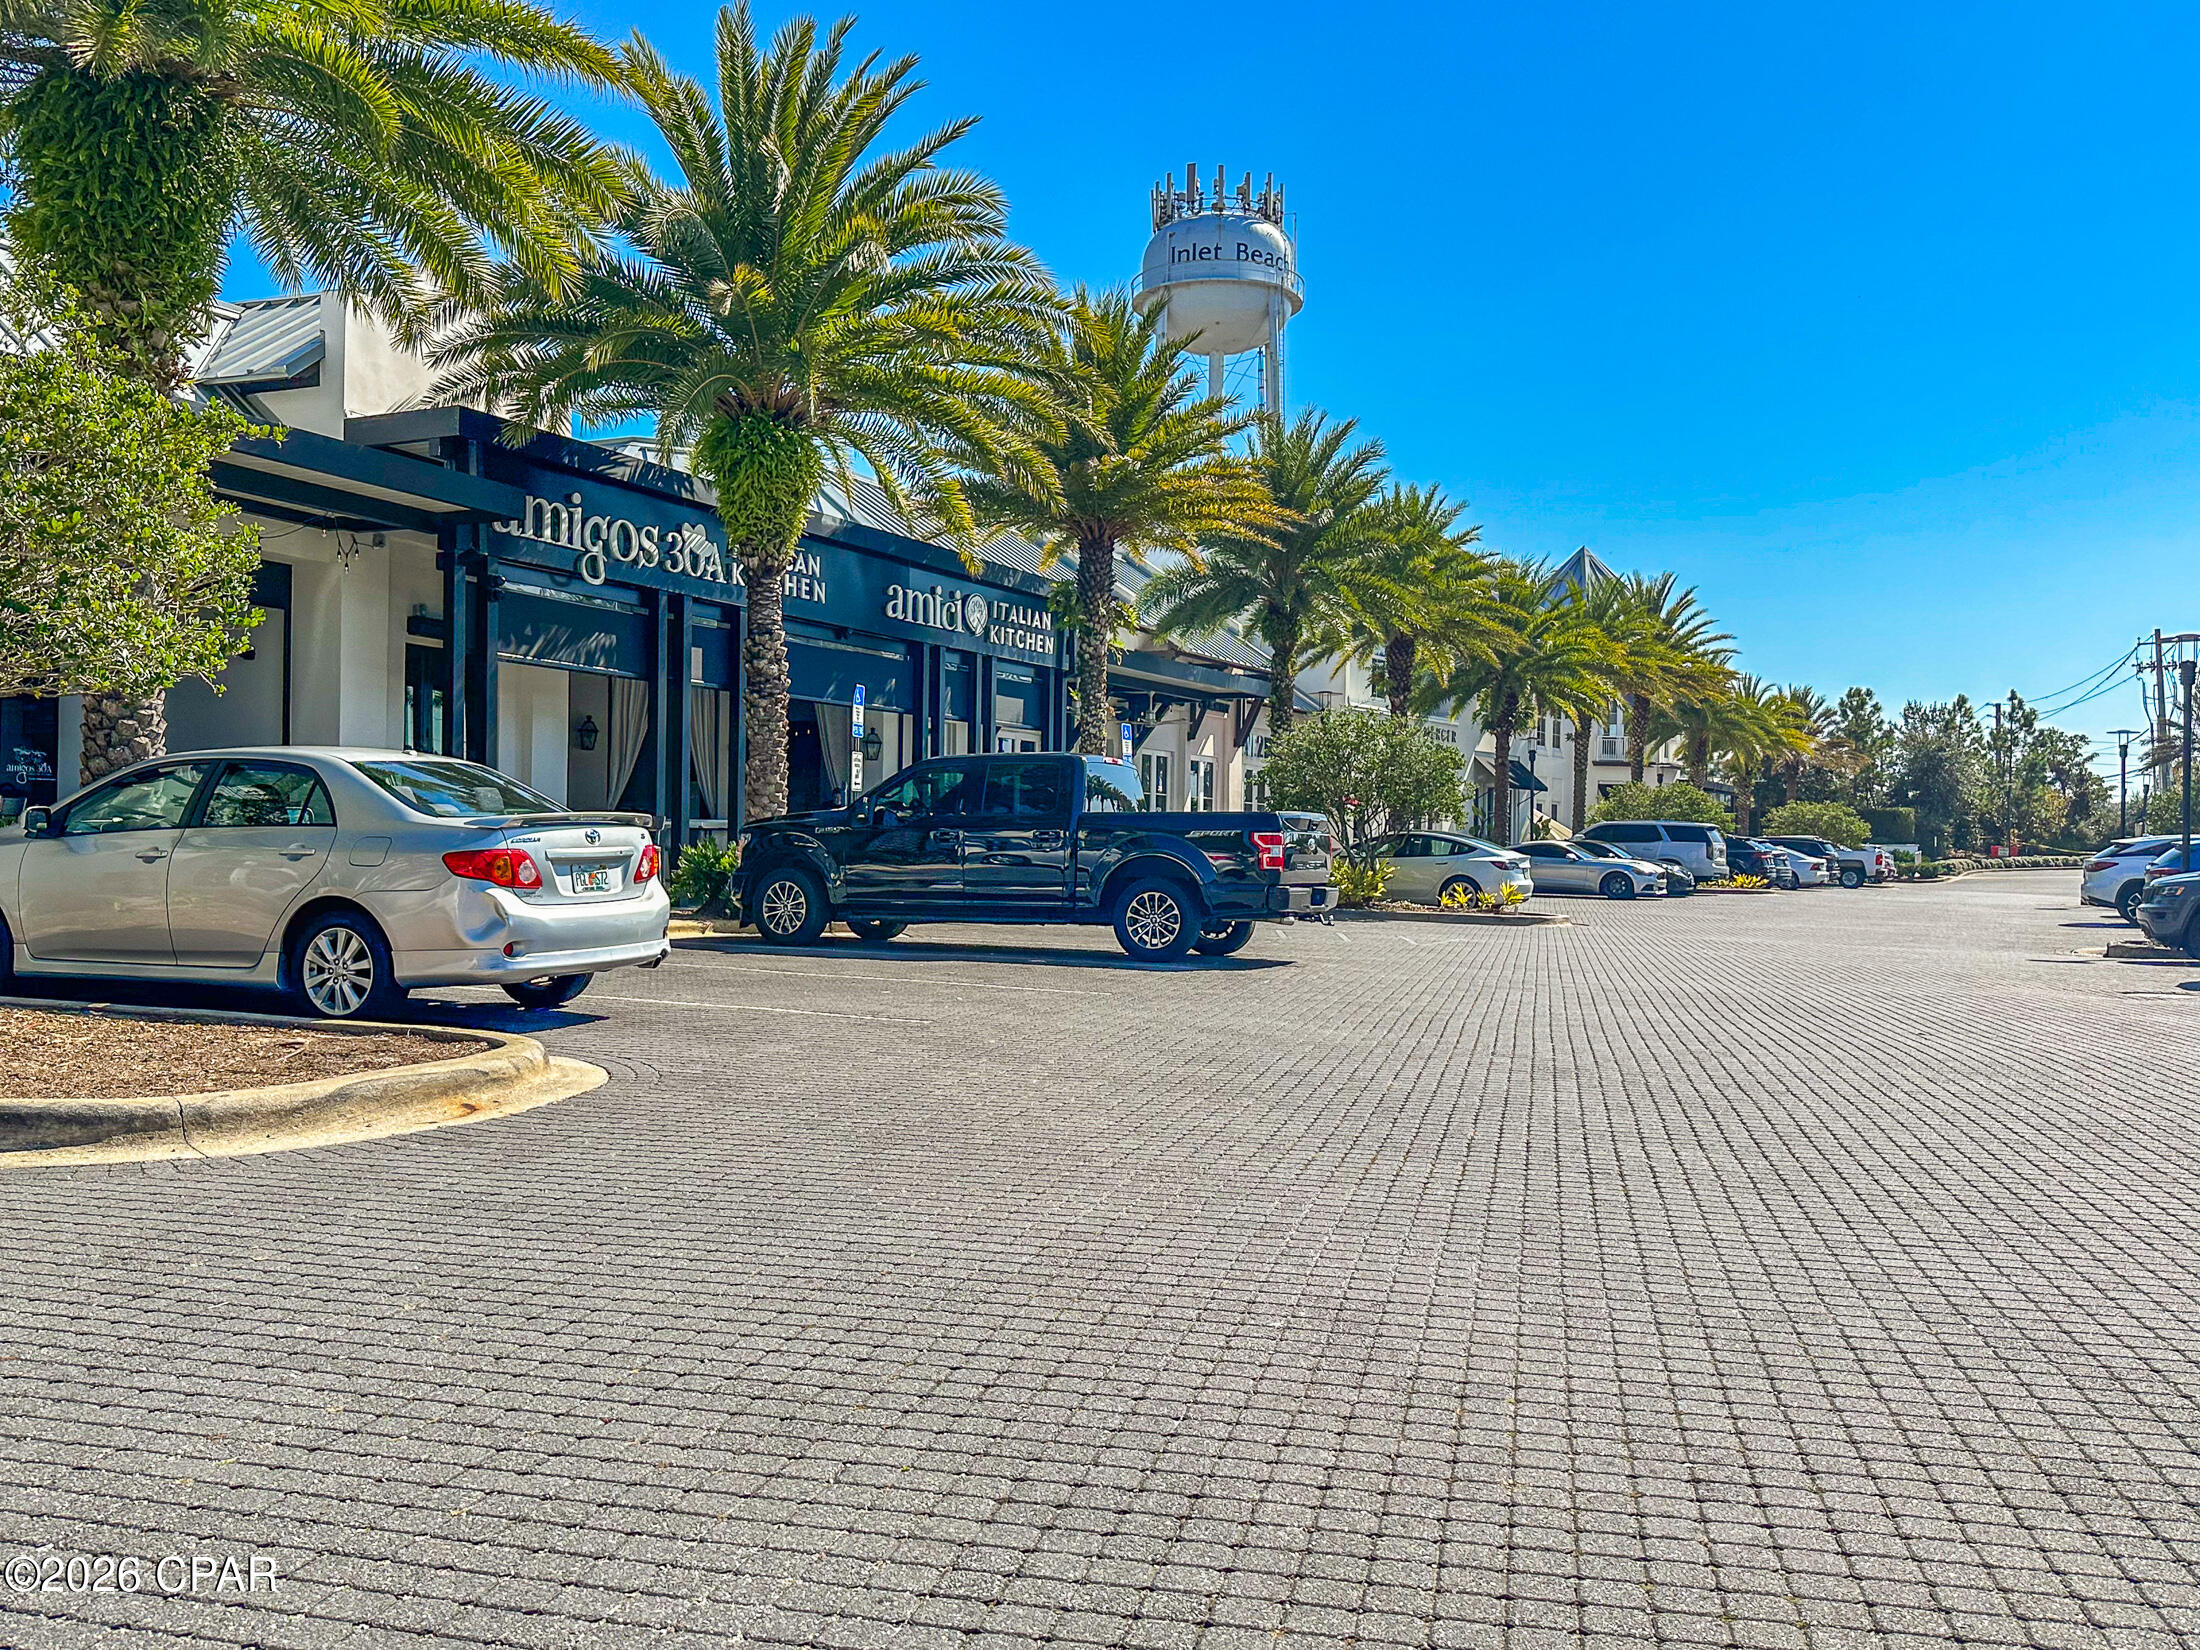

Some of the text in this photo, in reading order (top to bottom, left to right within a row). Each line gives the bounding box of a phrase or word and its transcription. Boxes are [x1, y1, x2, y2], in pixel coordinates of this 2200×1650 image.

[1171, 242, 1222, 264] Inlet
[885, 584, 965, 633] amici
[992, 600, 1052, 631] ITALIAN
[989, 624, 1054, 655] KITCHEN
[1185, 829, 1242, 838] SPORT
